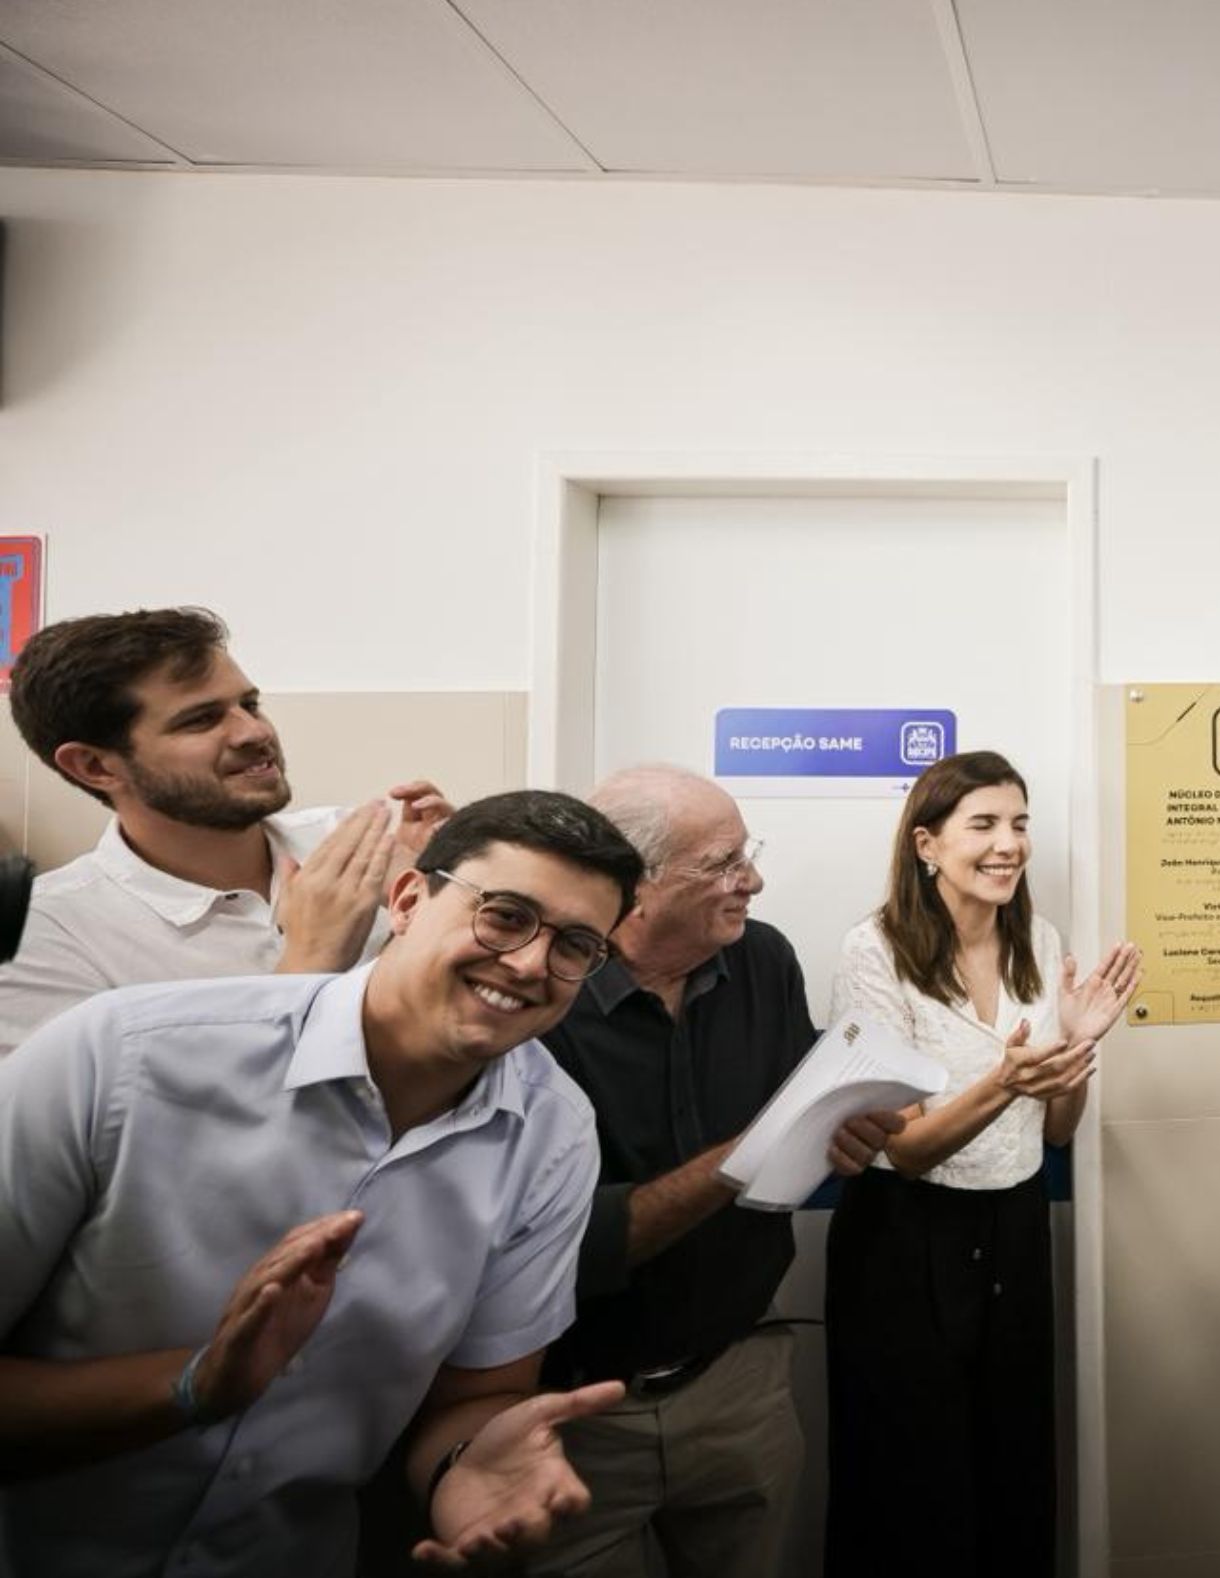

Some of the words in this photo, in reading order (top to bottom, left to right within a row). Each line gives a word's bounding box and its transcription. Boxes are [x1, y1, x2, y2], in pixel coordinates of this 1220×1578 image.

[729, 733, 815, 753] RECEPÇÃO
[818, 737, 863, 750] SAME
[1168, 788, 1213, 799] NÚCLEO
[1166, 804, 1218, 812] INTEGRAL
[1166, 814, 1215, 826] ANTÔNIO
